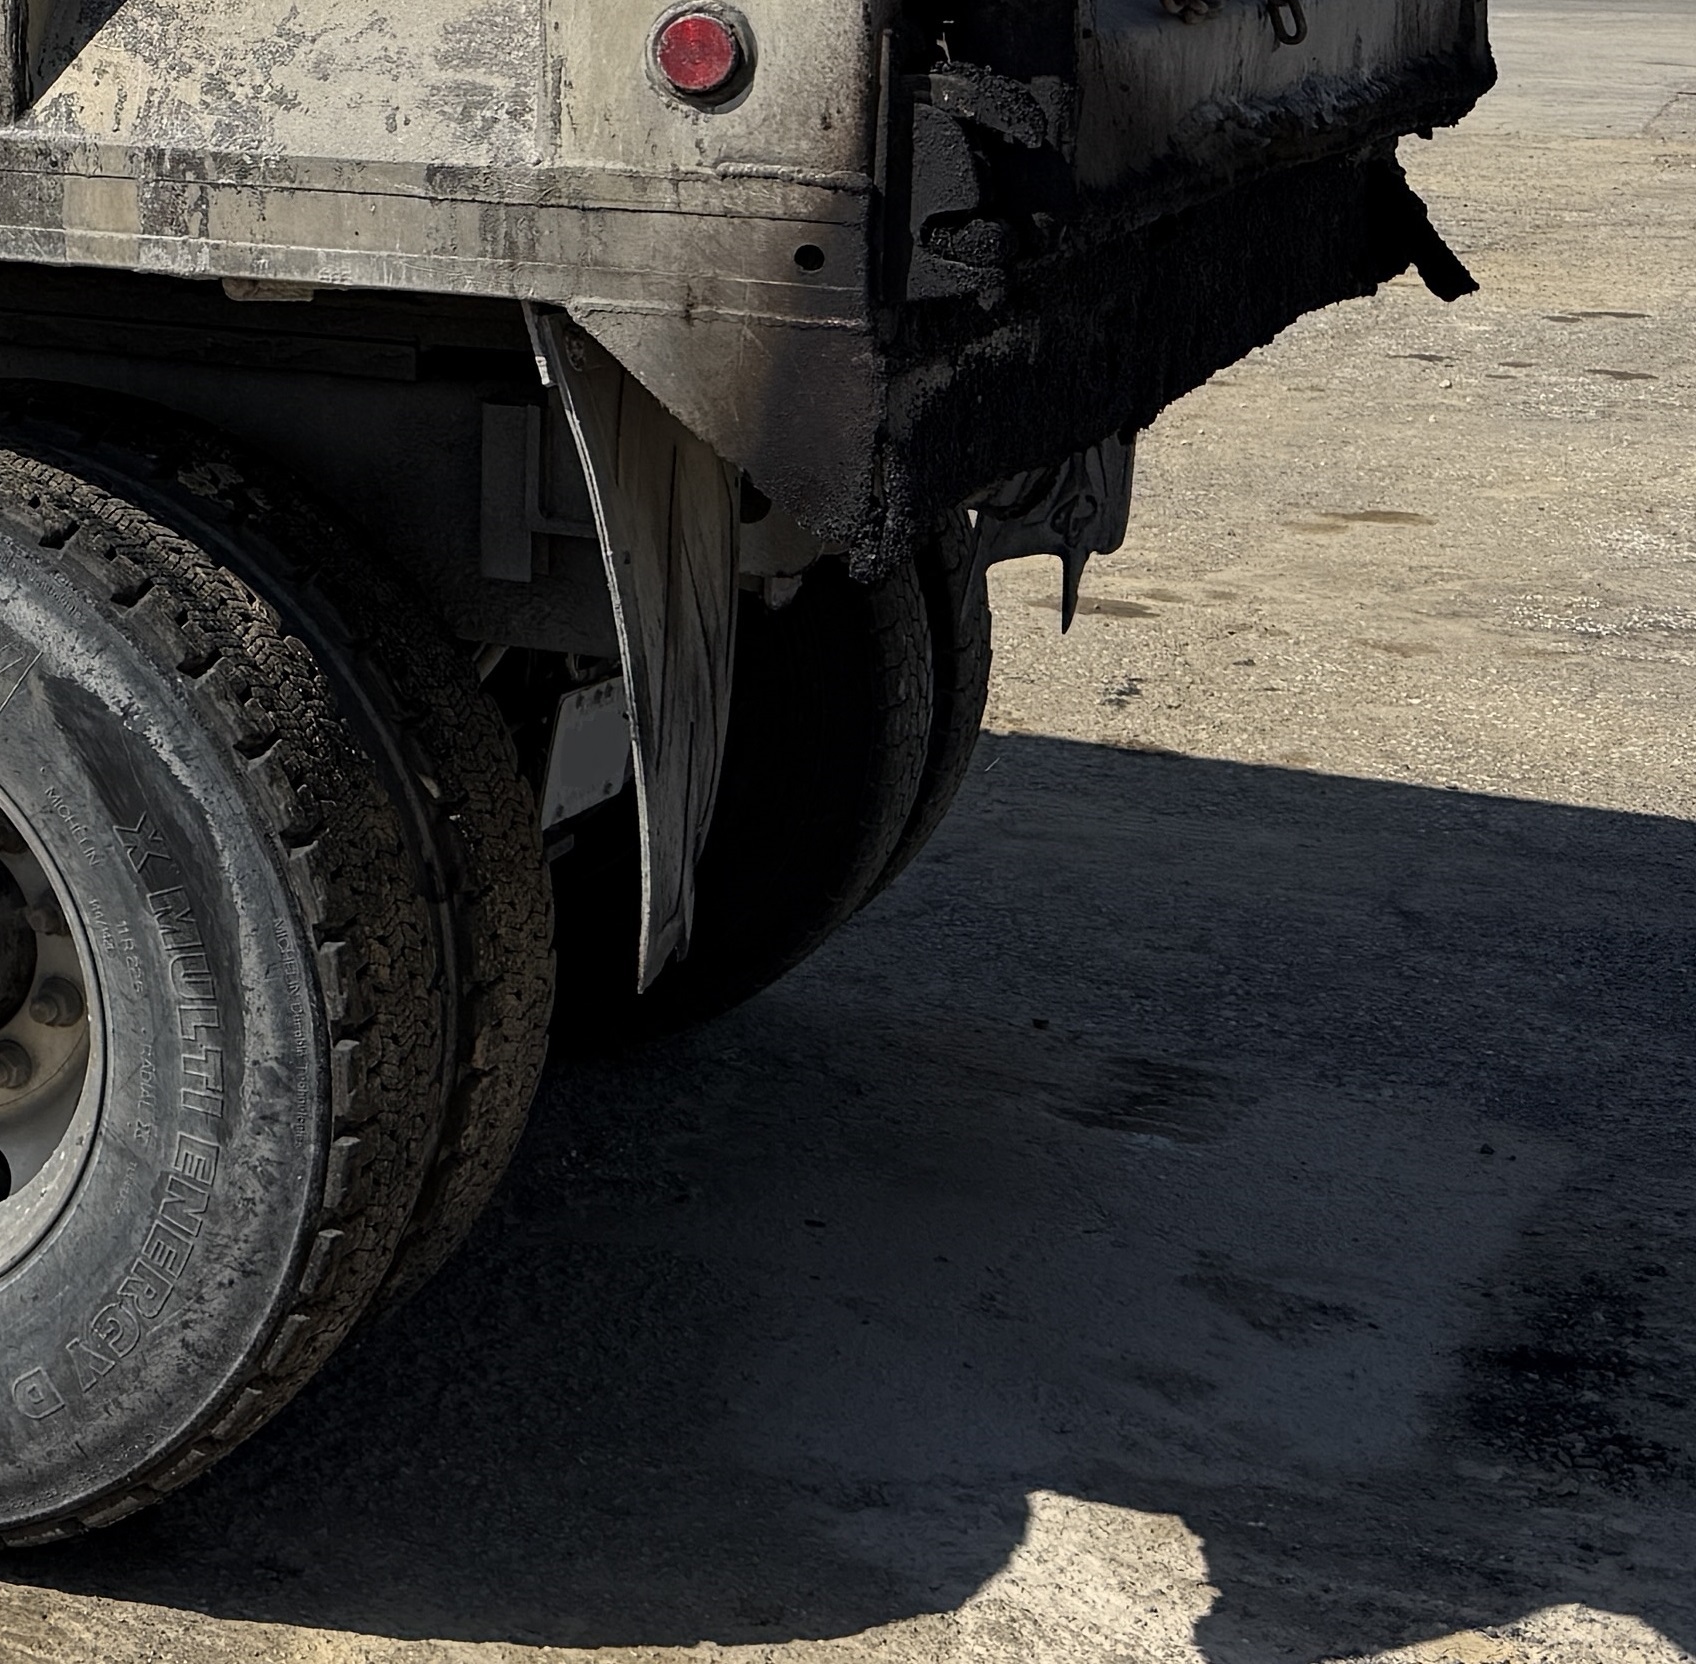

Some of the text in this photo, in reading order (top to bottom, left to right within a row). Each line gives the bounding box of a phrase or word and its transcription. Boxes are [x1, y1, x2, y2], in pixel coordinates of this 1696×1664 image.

[44, 785, 101, 868] MICHELIN
[272, 916, 303, 998] MICHELIN
[11, 810, 224, 1421] X MULTI ENERGY D
